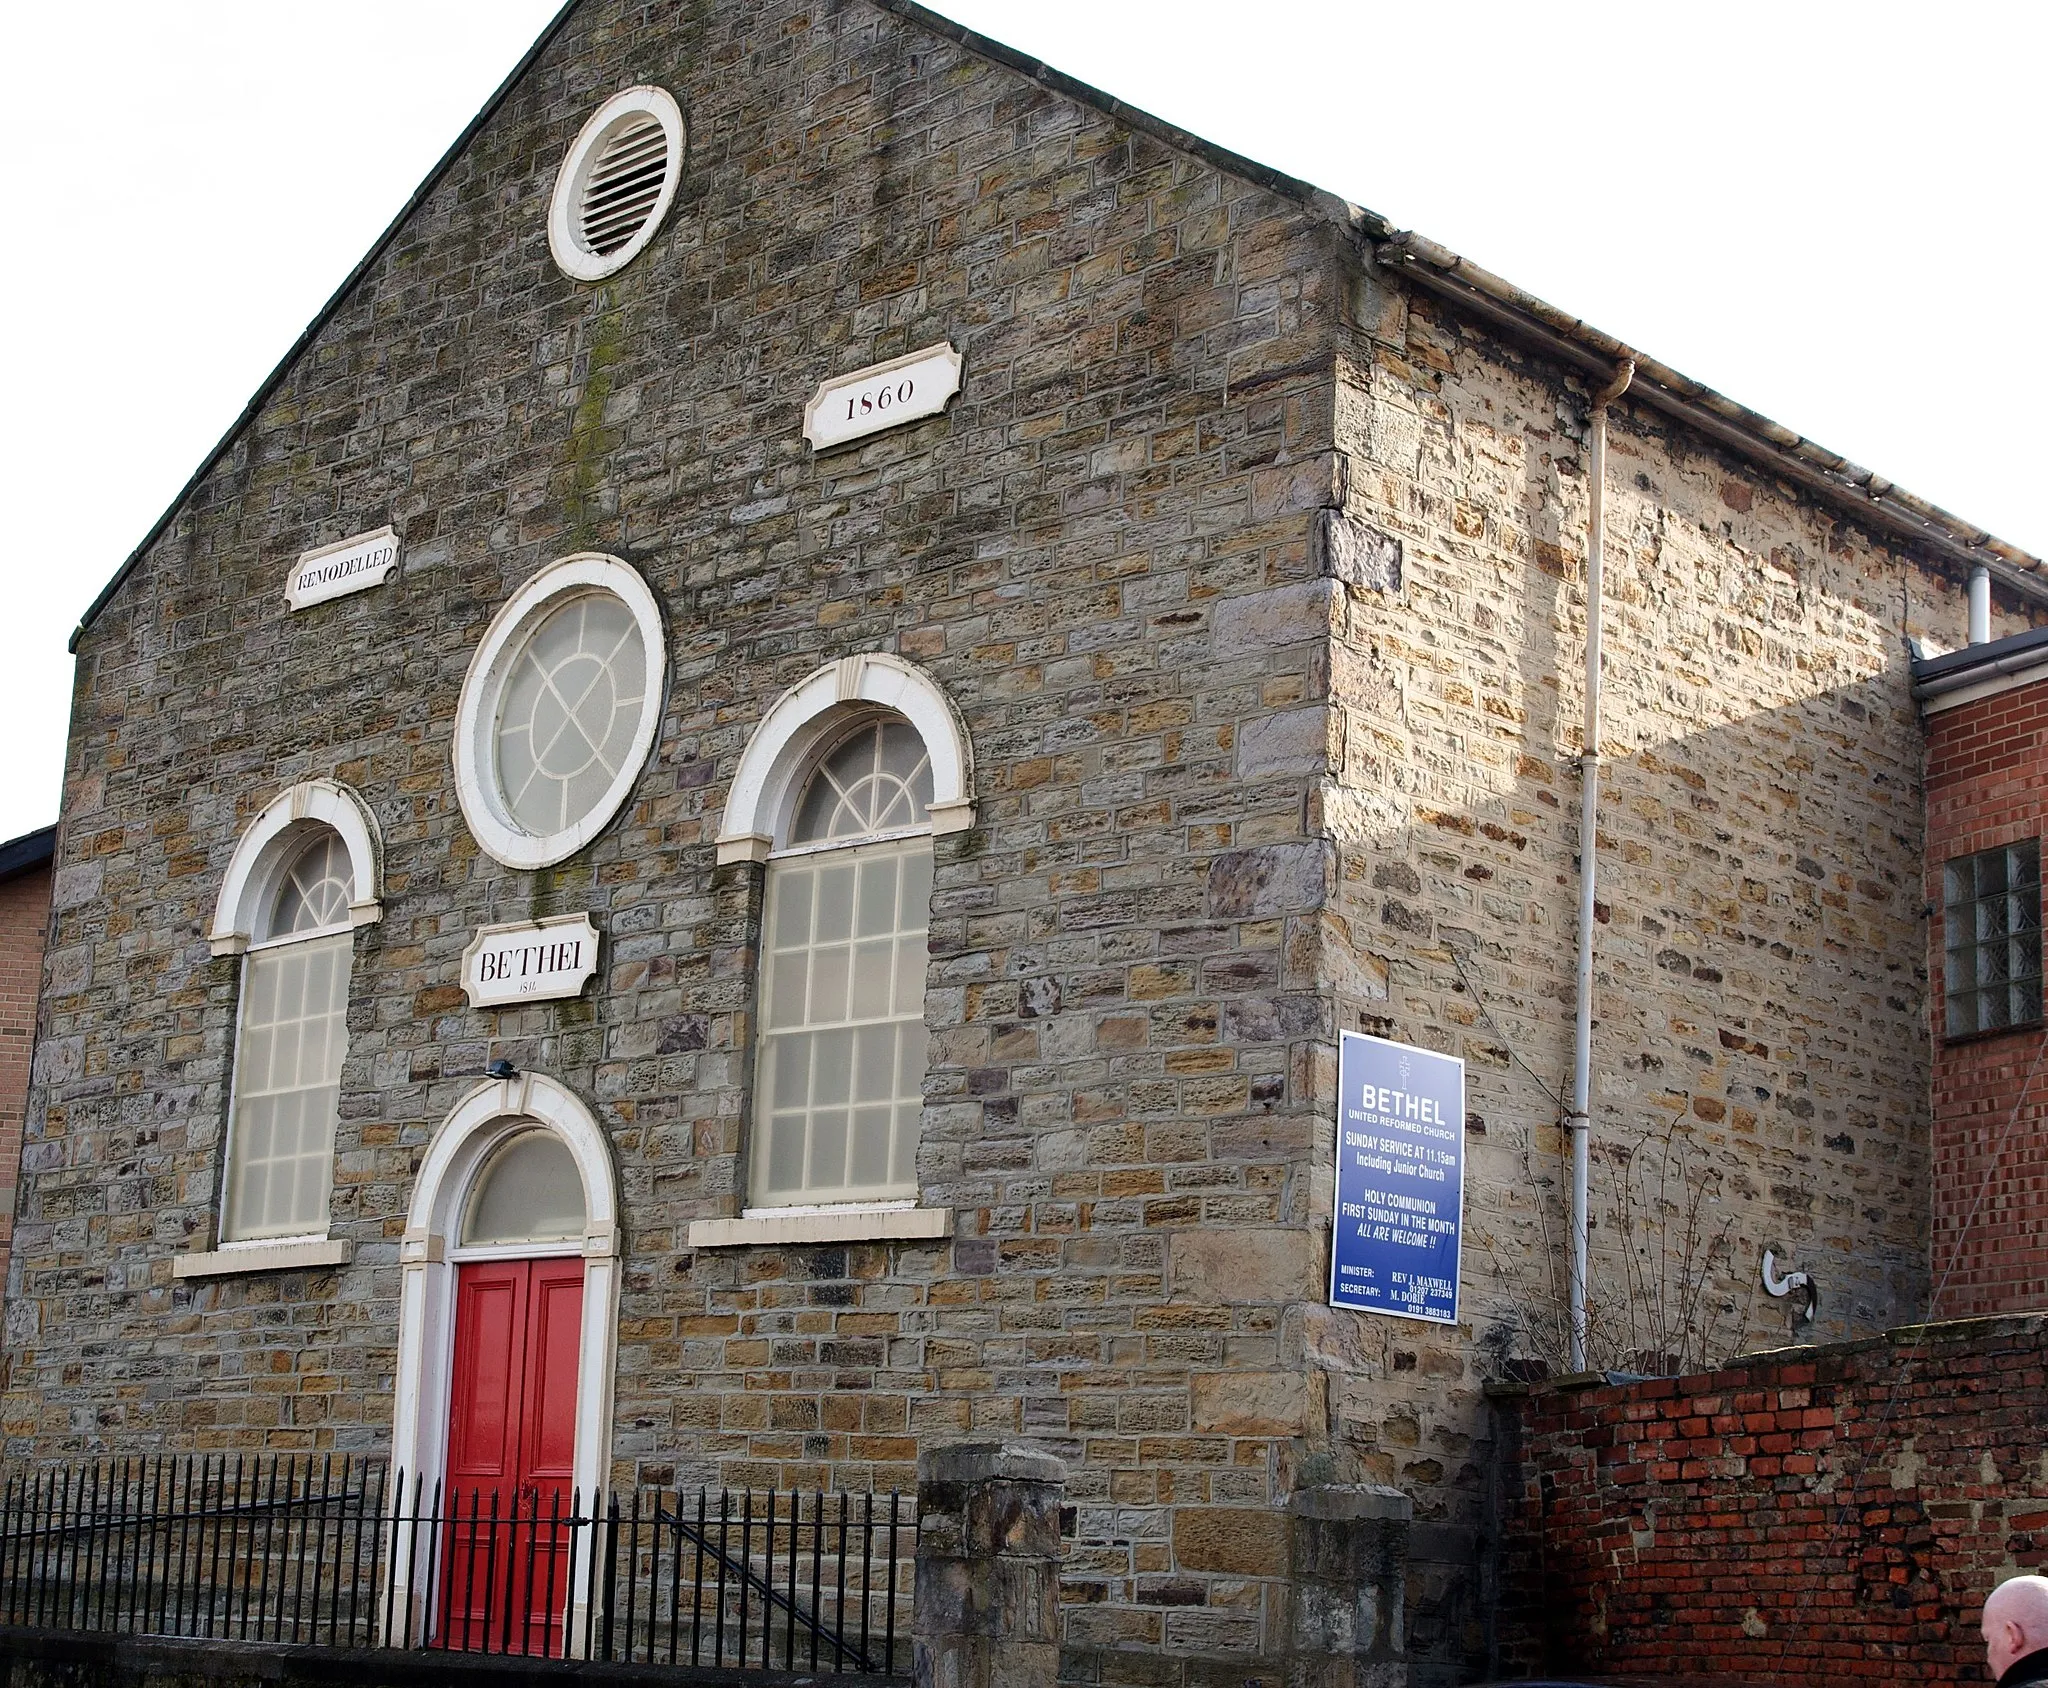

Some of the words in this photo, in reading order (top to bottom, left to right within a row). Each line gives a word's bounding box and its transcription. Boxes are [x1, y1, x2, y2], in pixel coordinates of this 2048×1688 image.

[846, 379, 914, 420] 1860
[297, 547, 393, 591] REMODELLED
[480, 941, 583, 982] BETHEL
[1362, 1083, 1446, 1126] BETHEL
[1348, 1109, 1378, 1123] UNITED
[1379, 1116, 1422, 1134] REFORMED
[1423, 1126, 1455, 1142] CHURCH
[1345, 1131, 1378, 1150] SUNDAY
[1379, 1138, 1413, 1158] SERVICE
[1414, 1145, 1424, 1160] AT
[1426, 1149, 1456, 1166] 11.15am
[1356, 1151, 1392, 1174] Including
[1393, 1160, 1417, 1176] Junior
[1418, 1164, 1445, 1182] Church
[1364, 1188, 1386, 1204] HOLY
[1387, 1193, 1436, 1215] COMMUNION
[1342, 1202, 1366, 1219] FIRST
[1367, 1206, 1399, 1225] SUNDAY
[1400, 1213, 1410, 1227] IN
[1411, 1215, 1426, 1230] THE
[1427, 1218, 1455, 1235] MONTH
[1357, 1222, 1371, 1238] ALL
[1372, 1225, 1390, 1241] ARE
[1391, 1228, 1428, 1248] WELCOME
[1429, 1236, 1437, 1249] !!
[1340, 1264, 1375, 1278] MINISTER:
[1391, 1271, 1408, 1284] REV
[1408, 1274, 1415, 1286] J.
[1416, 1275, 1453, 1291] MAXWELL
[1409, 1285, 1429, 1296] 01207
[1430, 1288, 1453, 1299] 237349
[1340, 1283, 1381, 1297] SECRETARY:
[1390, 1289, 1400, 1301] M.
[1401, 1291, 1426, 1305] DOBIE
[1407, 1304, 1423, 1314] 0191
